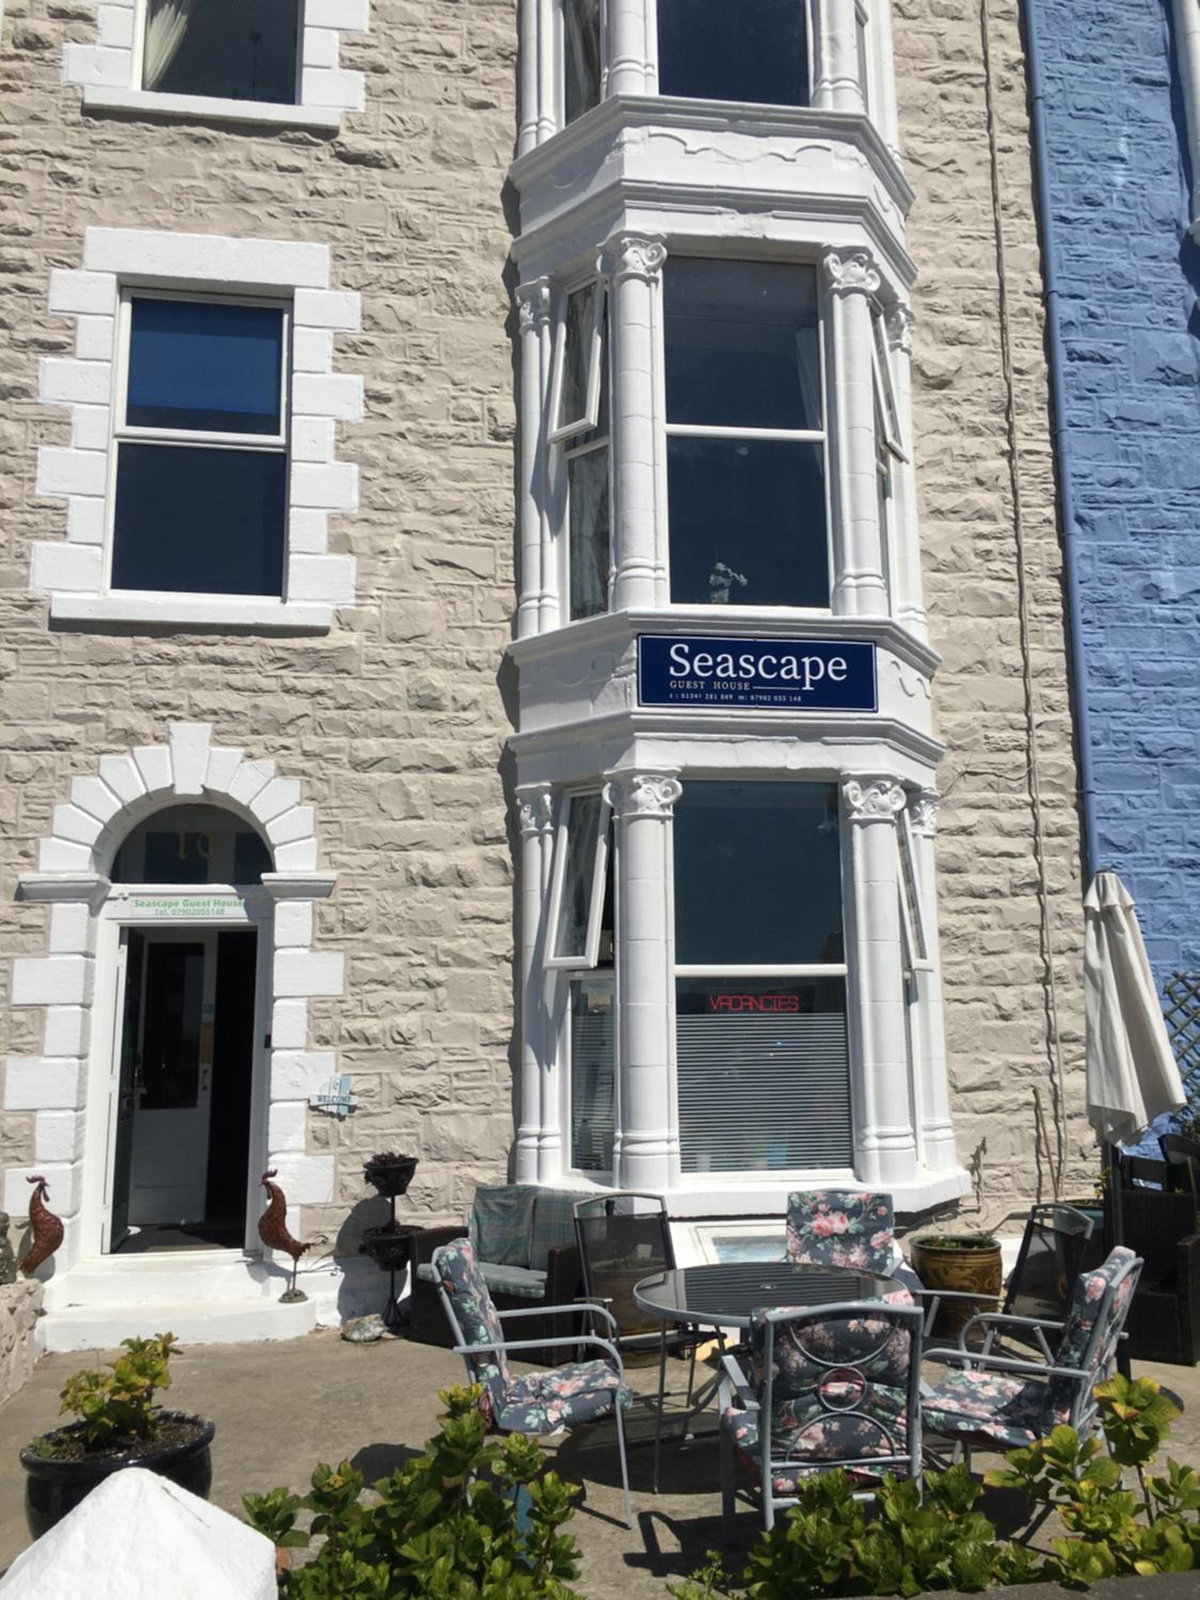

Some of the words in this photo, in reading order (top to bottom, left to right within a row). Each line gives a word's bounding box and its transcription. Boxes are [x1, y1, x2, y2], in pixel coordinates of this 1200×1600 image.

[669, 643, 848, 690] Seascape
[669, 680, 706, 690] GUEST
[713, 681, 750, 690] HOUSE
[134, 898, 180, 908] Seascape
[182, 898, 210, 907] Guest
[213, 898, 244, 907] House
[710, 994, 800, 1012] VACANCIES
